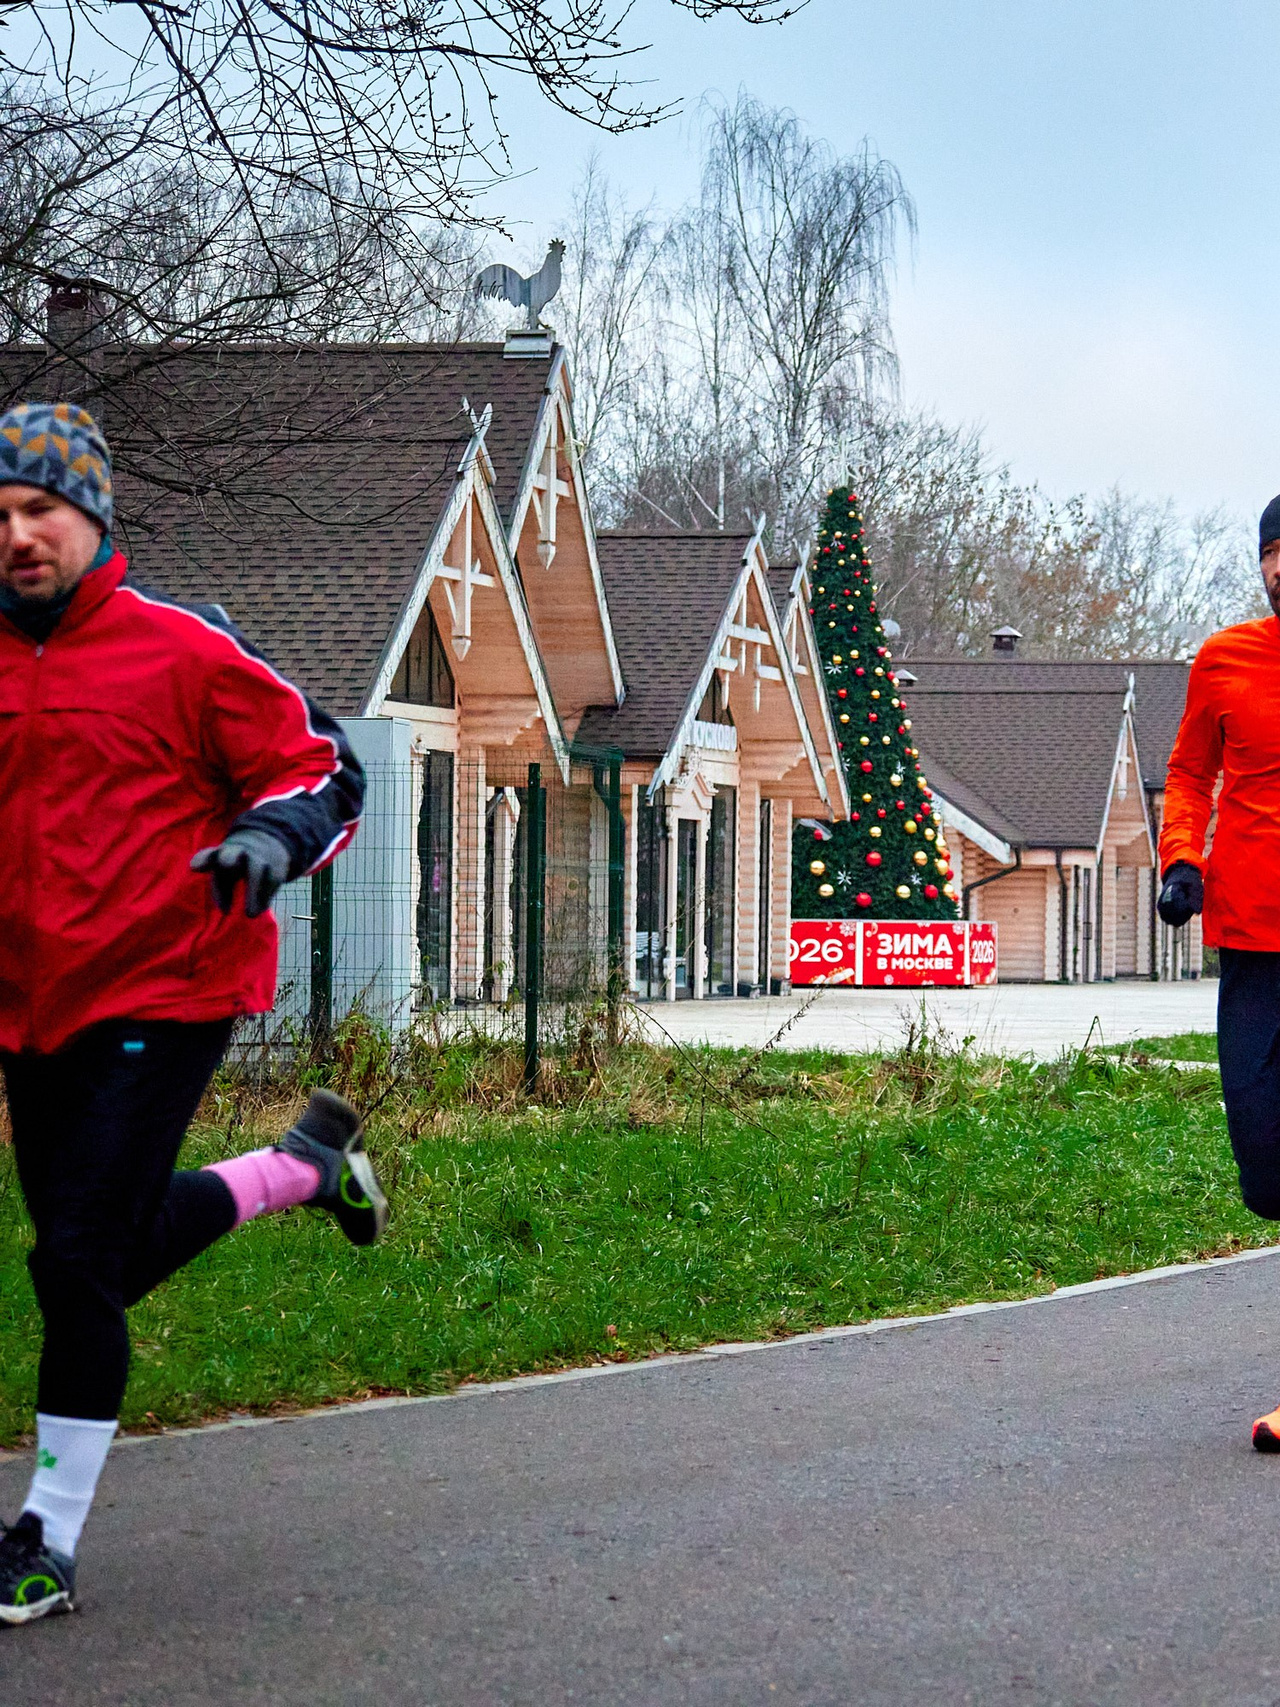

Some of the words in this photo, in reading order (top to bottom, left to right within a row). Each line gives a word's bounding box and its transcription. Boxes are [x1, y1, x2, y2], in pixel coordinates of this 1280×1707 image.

[877, 933, 954, 956] ЗИМА
[972, 940, 994, 963] 2026
[877, 957, 888, 970] В
[891, 957, 954, 970] МОСКВЕ
